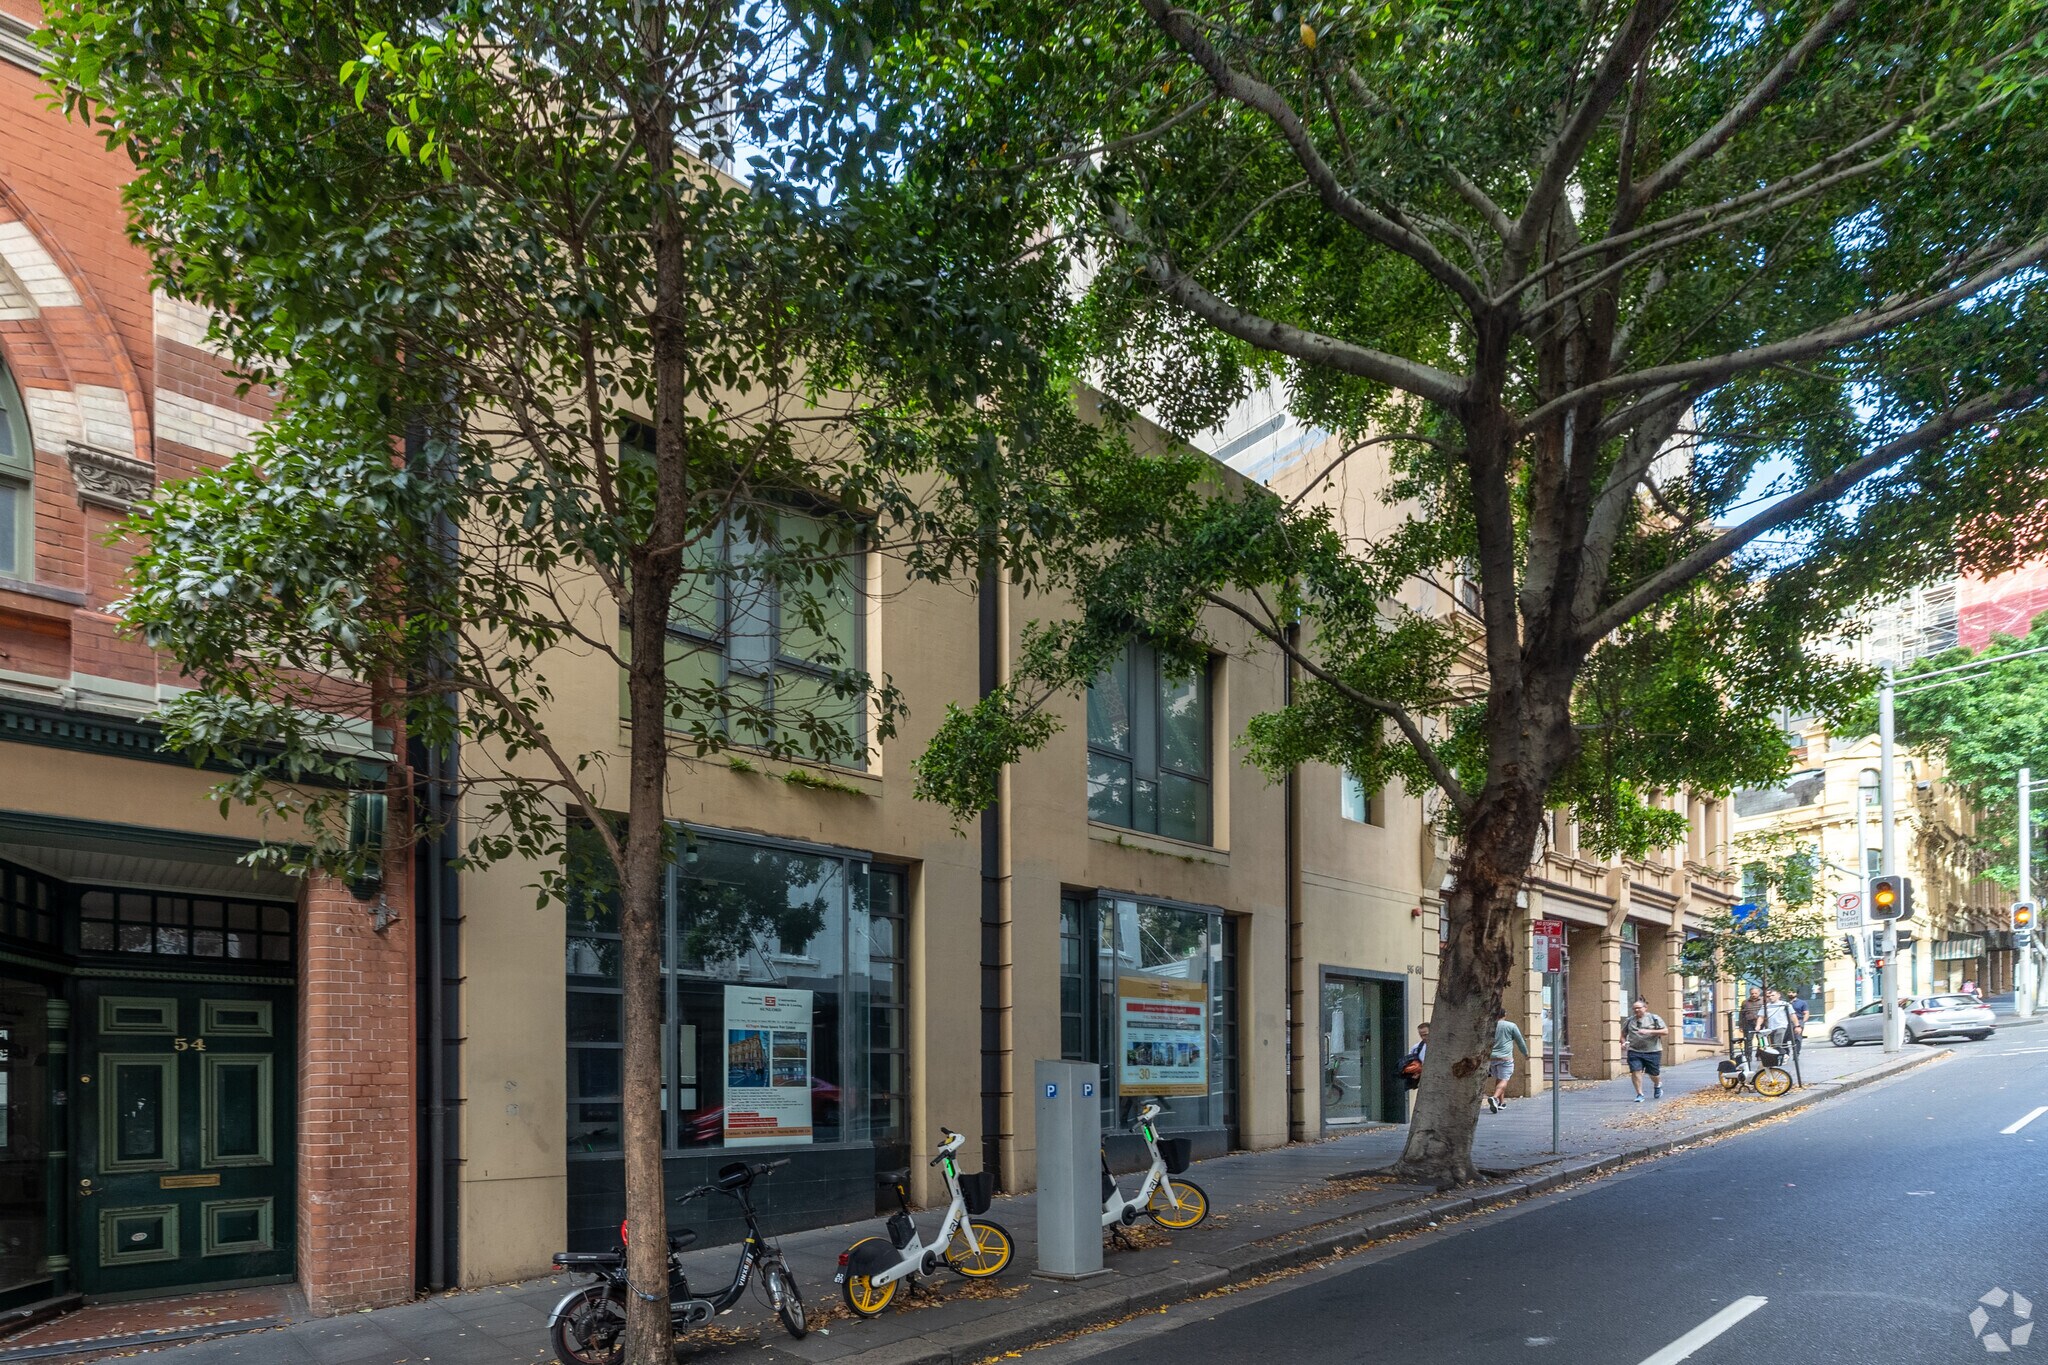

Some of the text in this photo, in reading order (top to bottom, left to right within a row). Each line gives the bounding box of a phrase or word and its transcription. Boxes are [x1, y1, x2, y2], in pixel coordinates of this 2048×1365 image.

[174, 1038, 207, 1051] 54
[1139, 1068, 1151, 1080] 30
[1047, 1085, 1055, 1097] P
[1084, 1084, 1092, 1096] P
